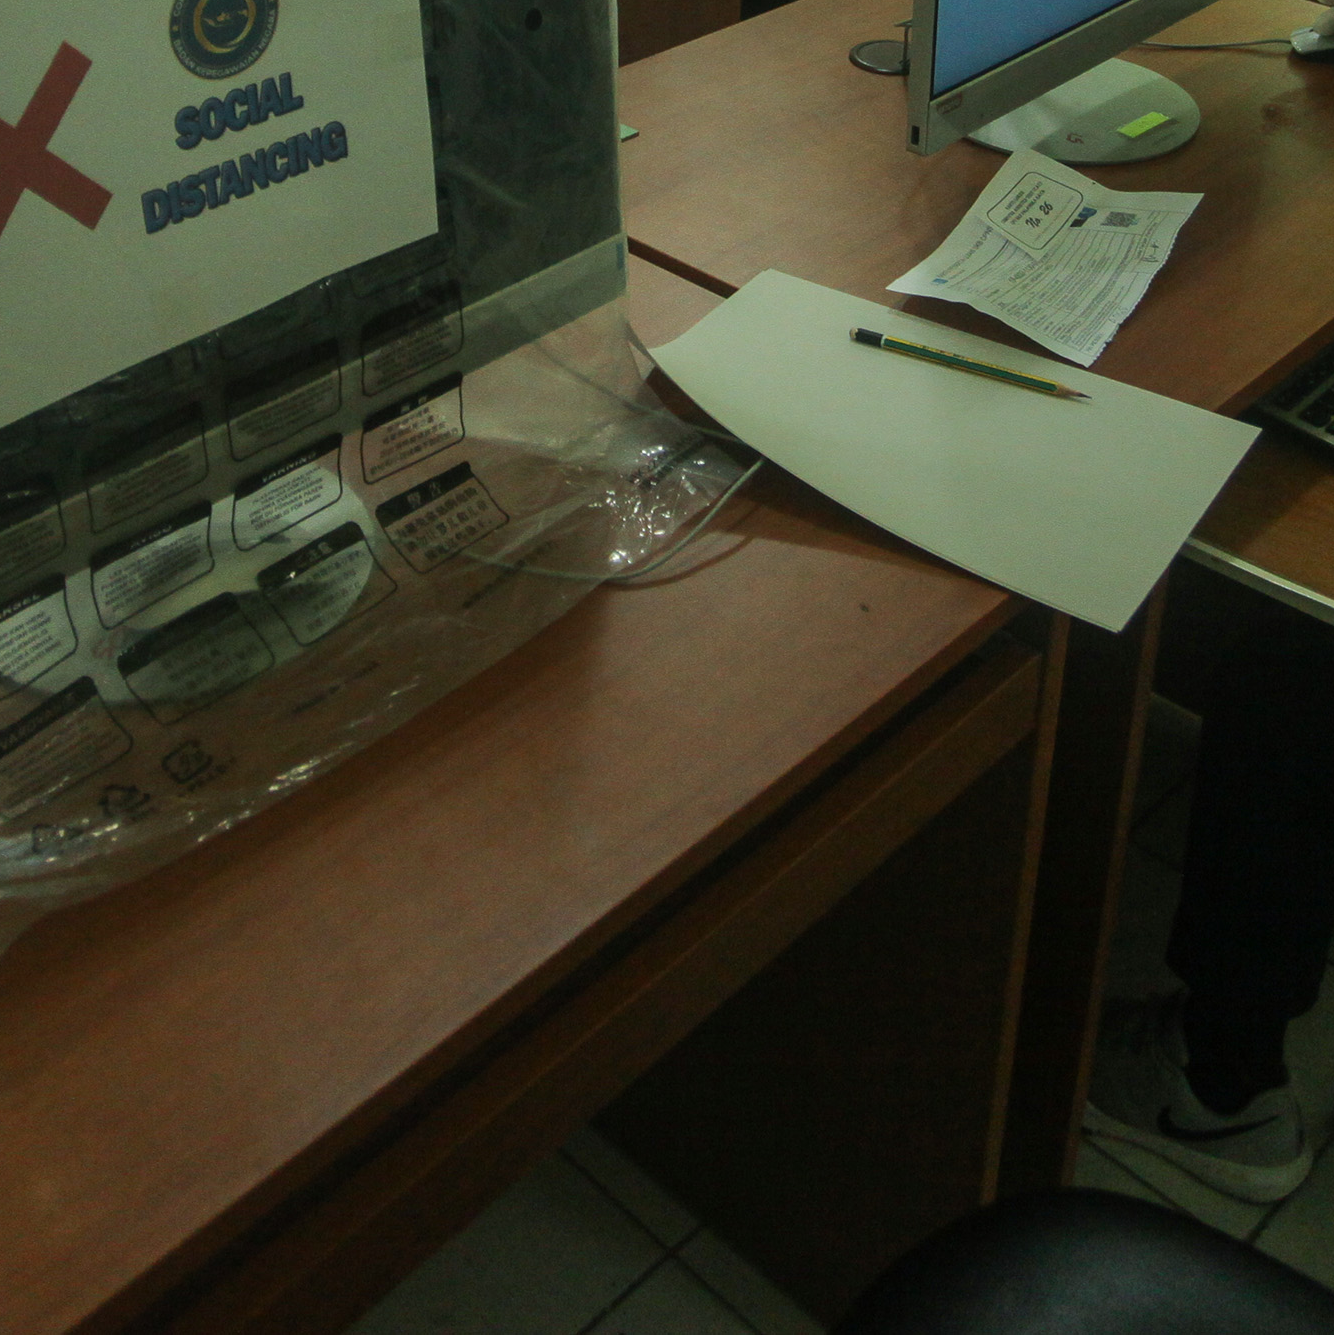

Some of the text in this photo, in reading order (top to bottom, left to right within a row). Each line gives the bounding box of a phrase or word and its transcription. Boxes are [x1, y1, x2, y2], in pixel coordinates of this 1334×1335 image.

[172, 38, 197, 69] BADAN
[174, 72, 304, 150] SOCIAL
[141, 120, 348, 234] DISTANCING
